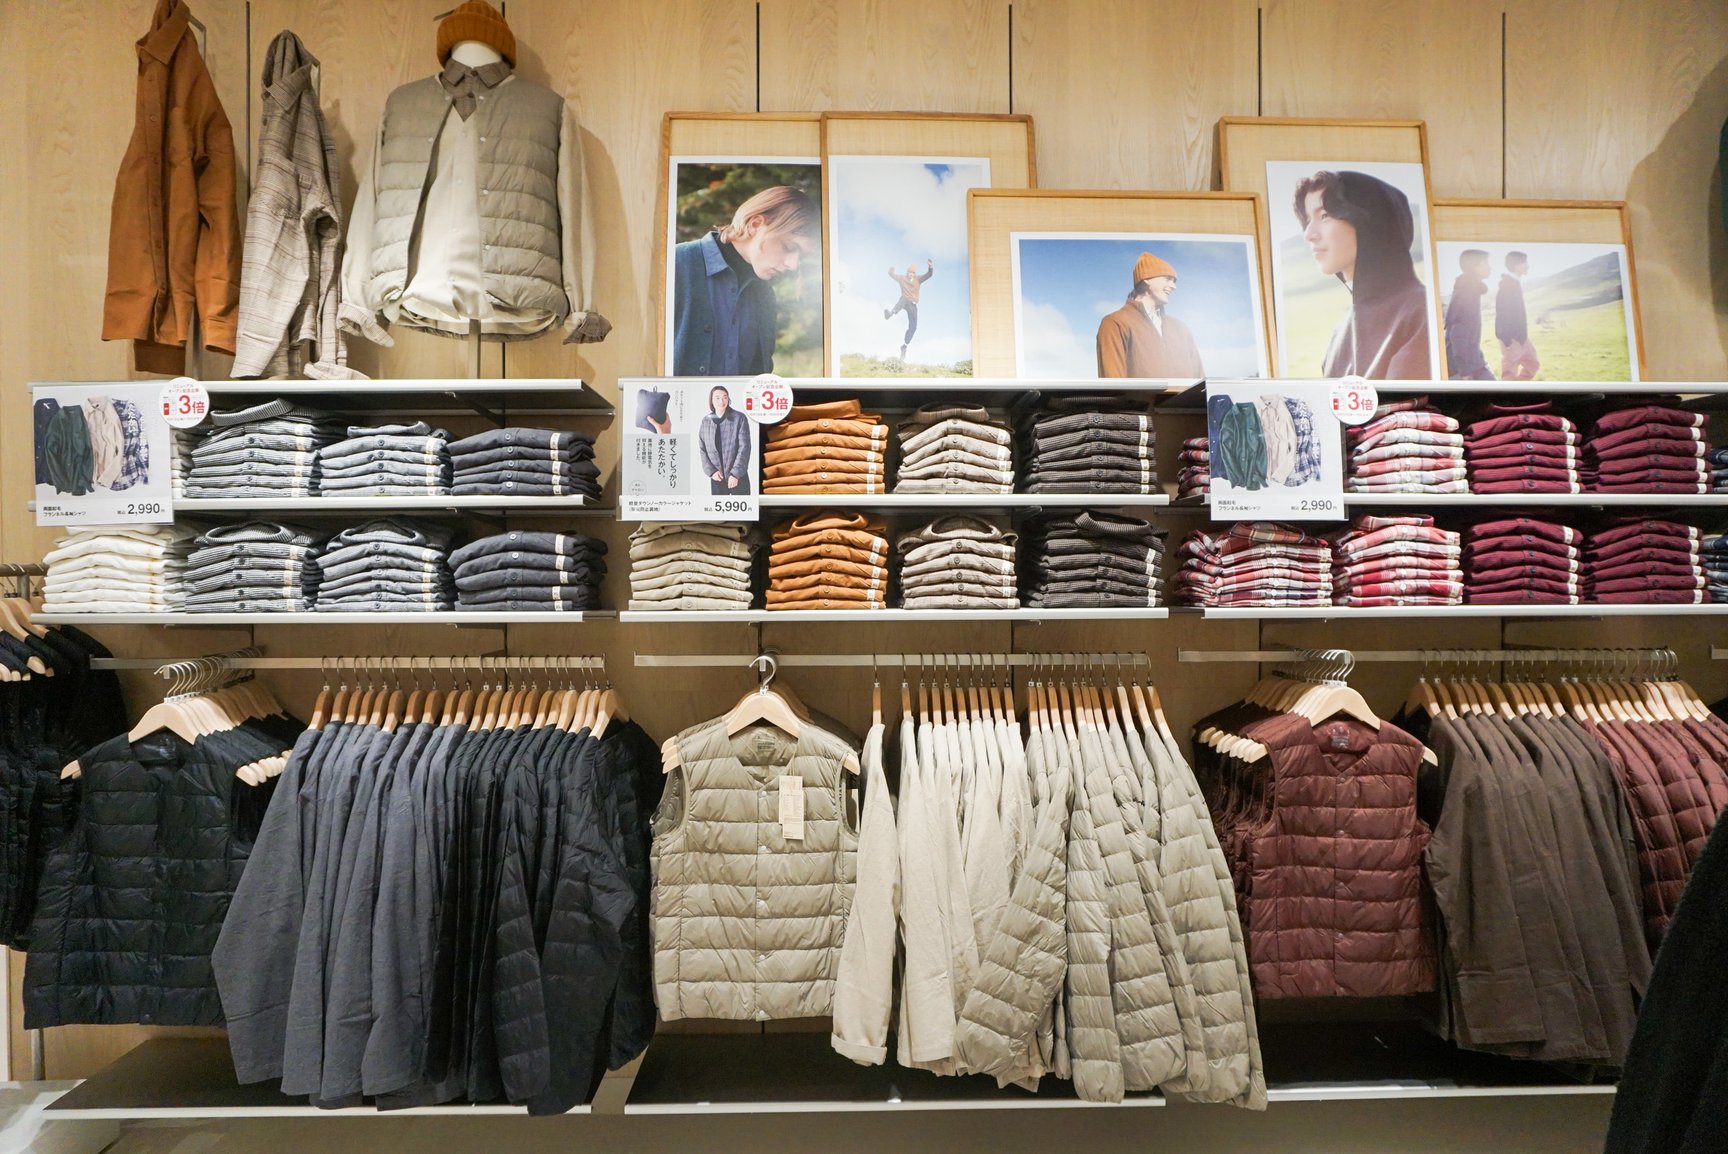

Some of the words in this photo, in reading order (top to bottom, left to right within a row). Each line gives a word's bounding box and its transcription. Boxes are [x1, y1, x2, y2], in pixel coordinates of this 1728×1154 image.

[669, 438, 677, 488] 軽くてしっかり
